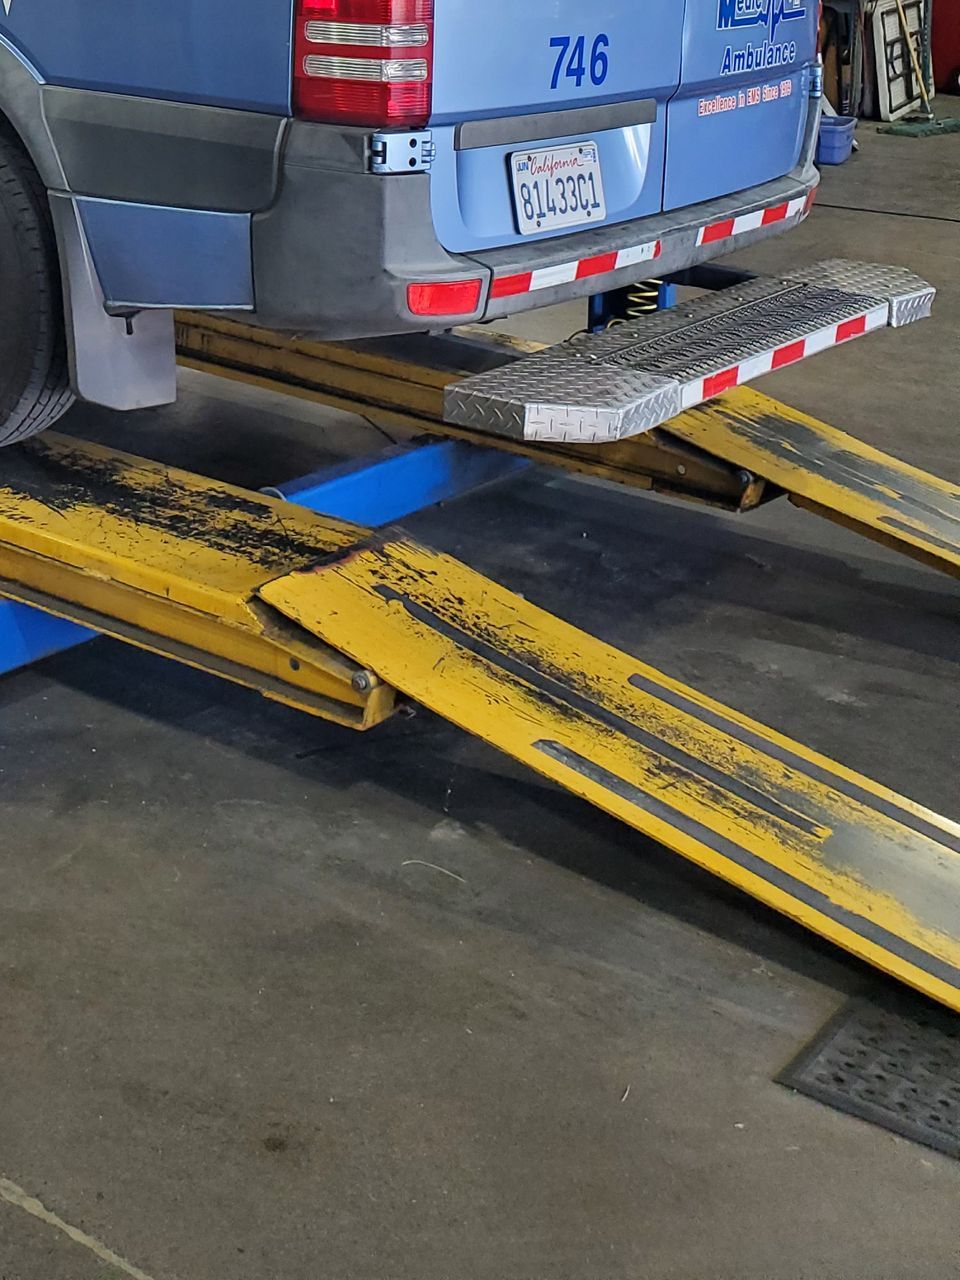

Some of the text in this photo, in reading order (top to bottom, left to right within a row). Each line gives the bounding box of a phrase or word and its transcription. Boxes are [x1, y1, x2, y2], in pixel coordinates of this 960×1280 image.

[549, 34, 608, 89] 746
[720, 41, 795, 75] Ambulance
[698, 95, 736, 116] Excellence
[738, 91, 745, 107] in
[747, 87, 760, 105] EMS
[762, 85, 778, 102] Since
[531, 154, 584, 177] California
[521, 172, 600, 220] 81433C1
